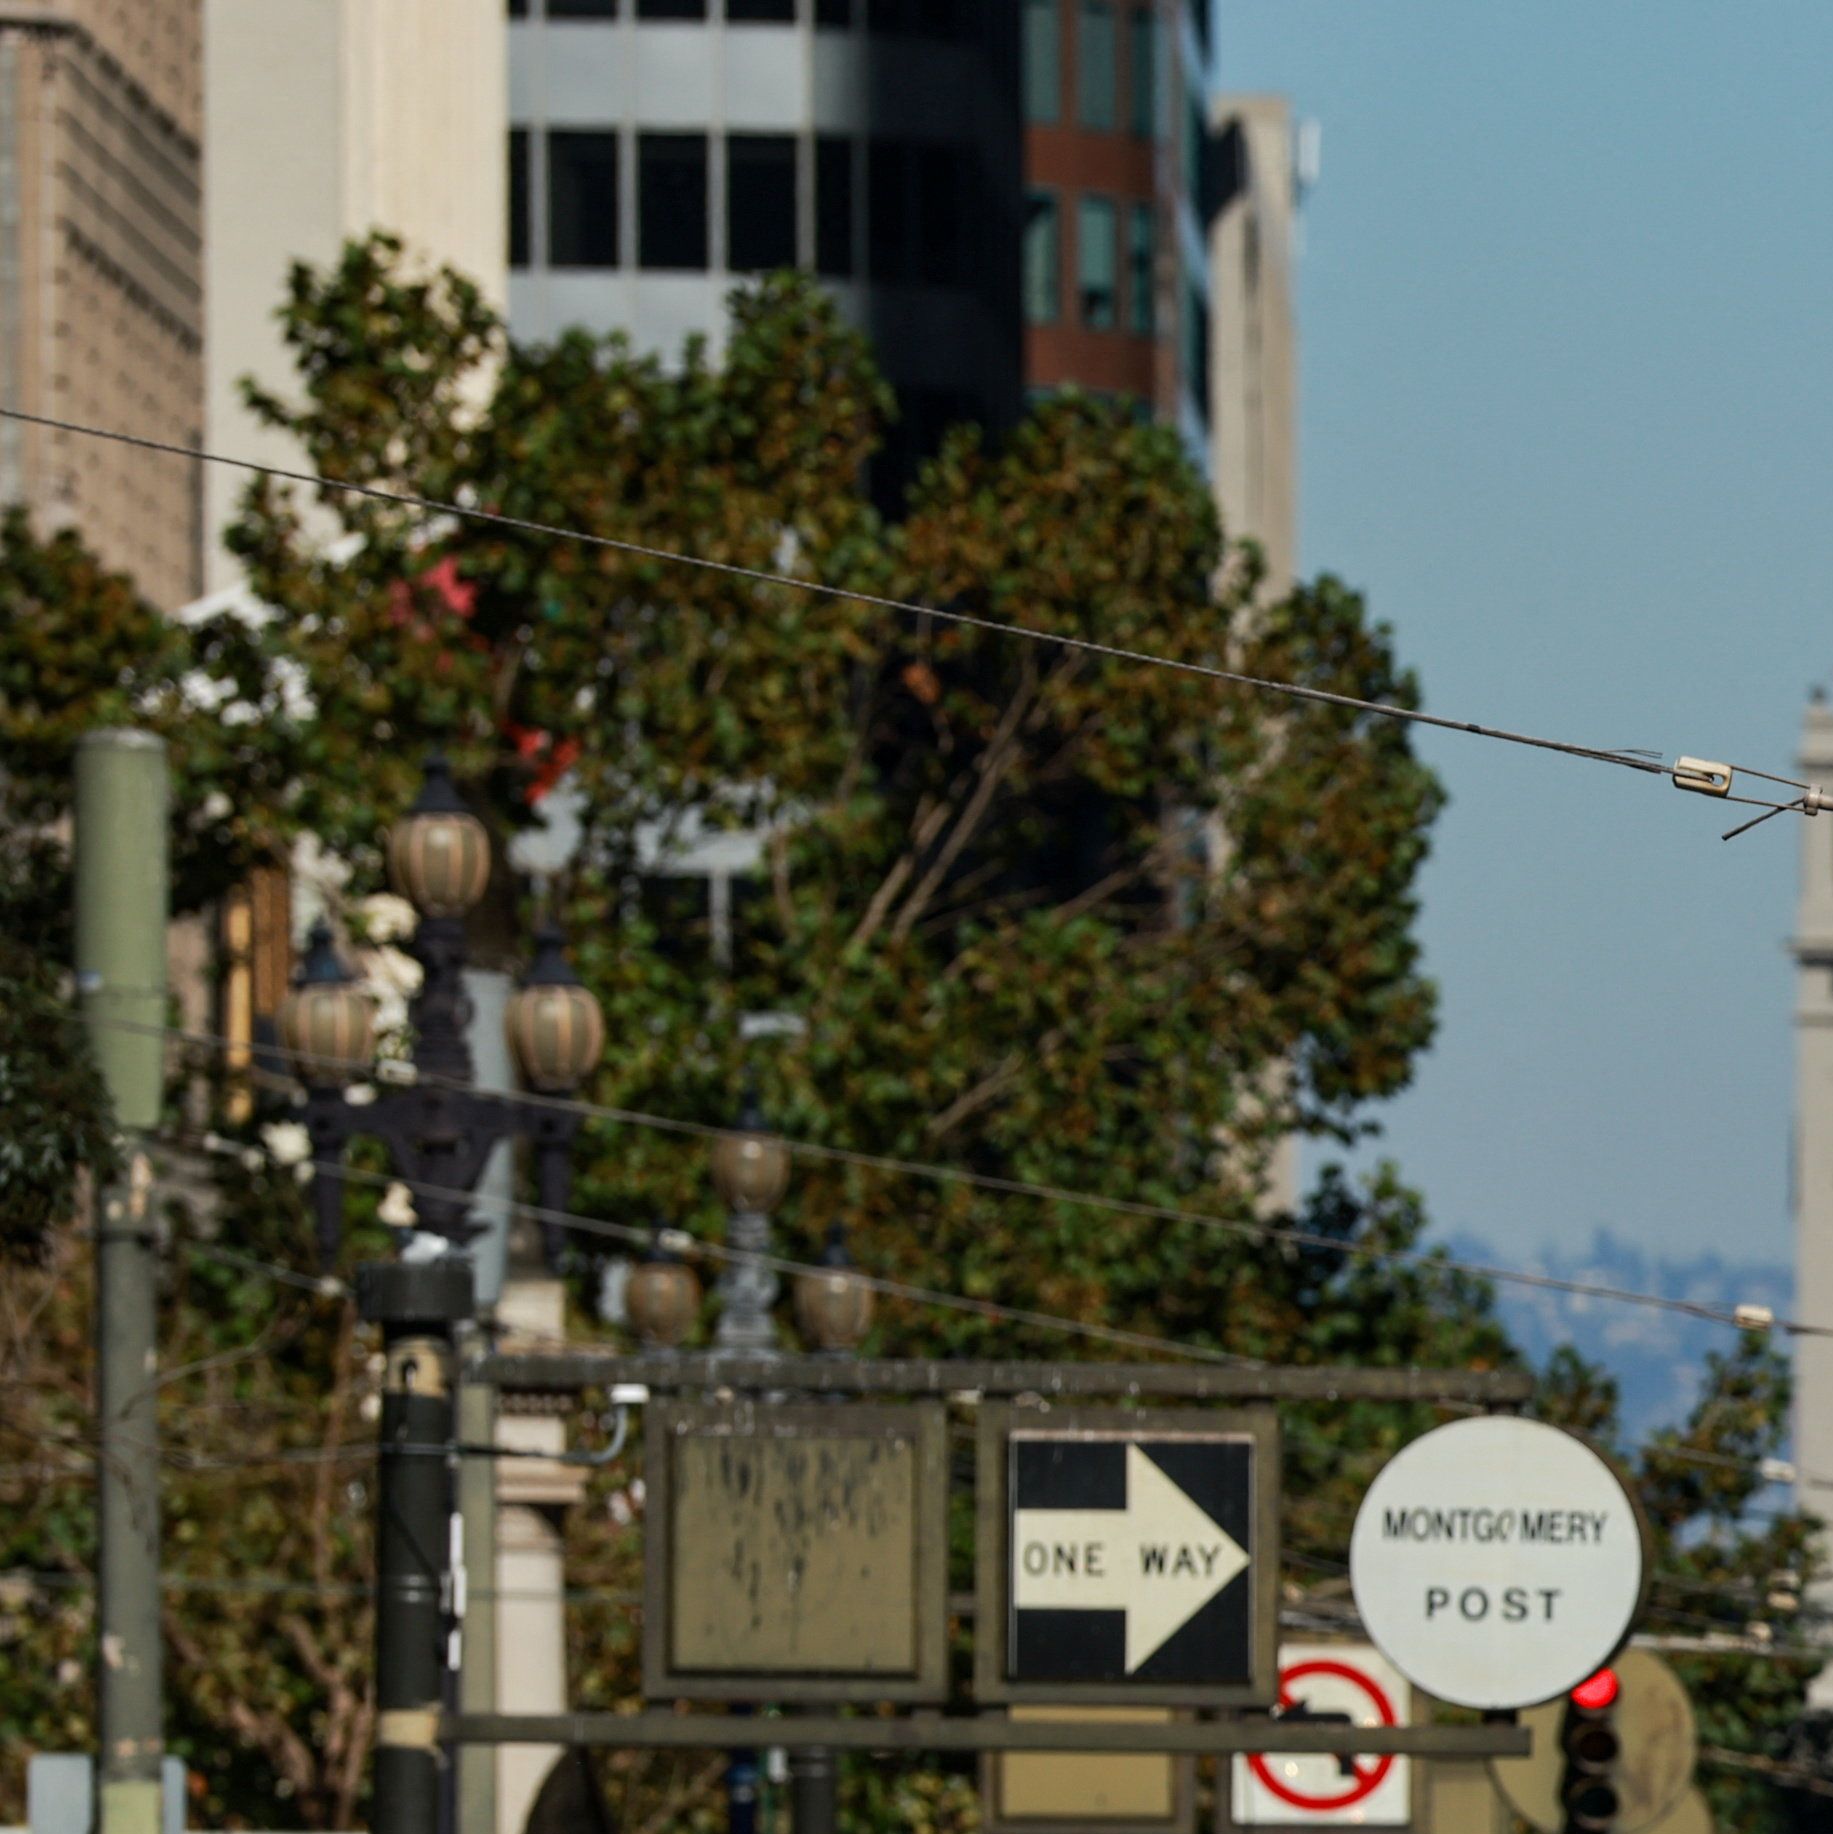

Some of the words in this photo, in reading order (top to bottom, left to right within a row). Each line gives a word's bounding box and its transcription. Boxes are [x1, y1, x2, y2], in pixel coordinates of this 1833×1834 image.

[1382, 1506, 1608, 1543] MONTGOMERY
[1023, 1543, 1106, 1578] ONE
[1140, 1543, 1221, 1578] WAY
[1425, 1588, 1562, 1622] POST
